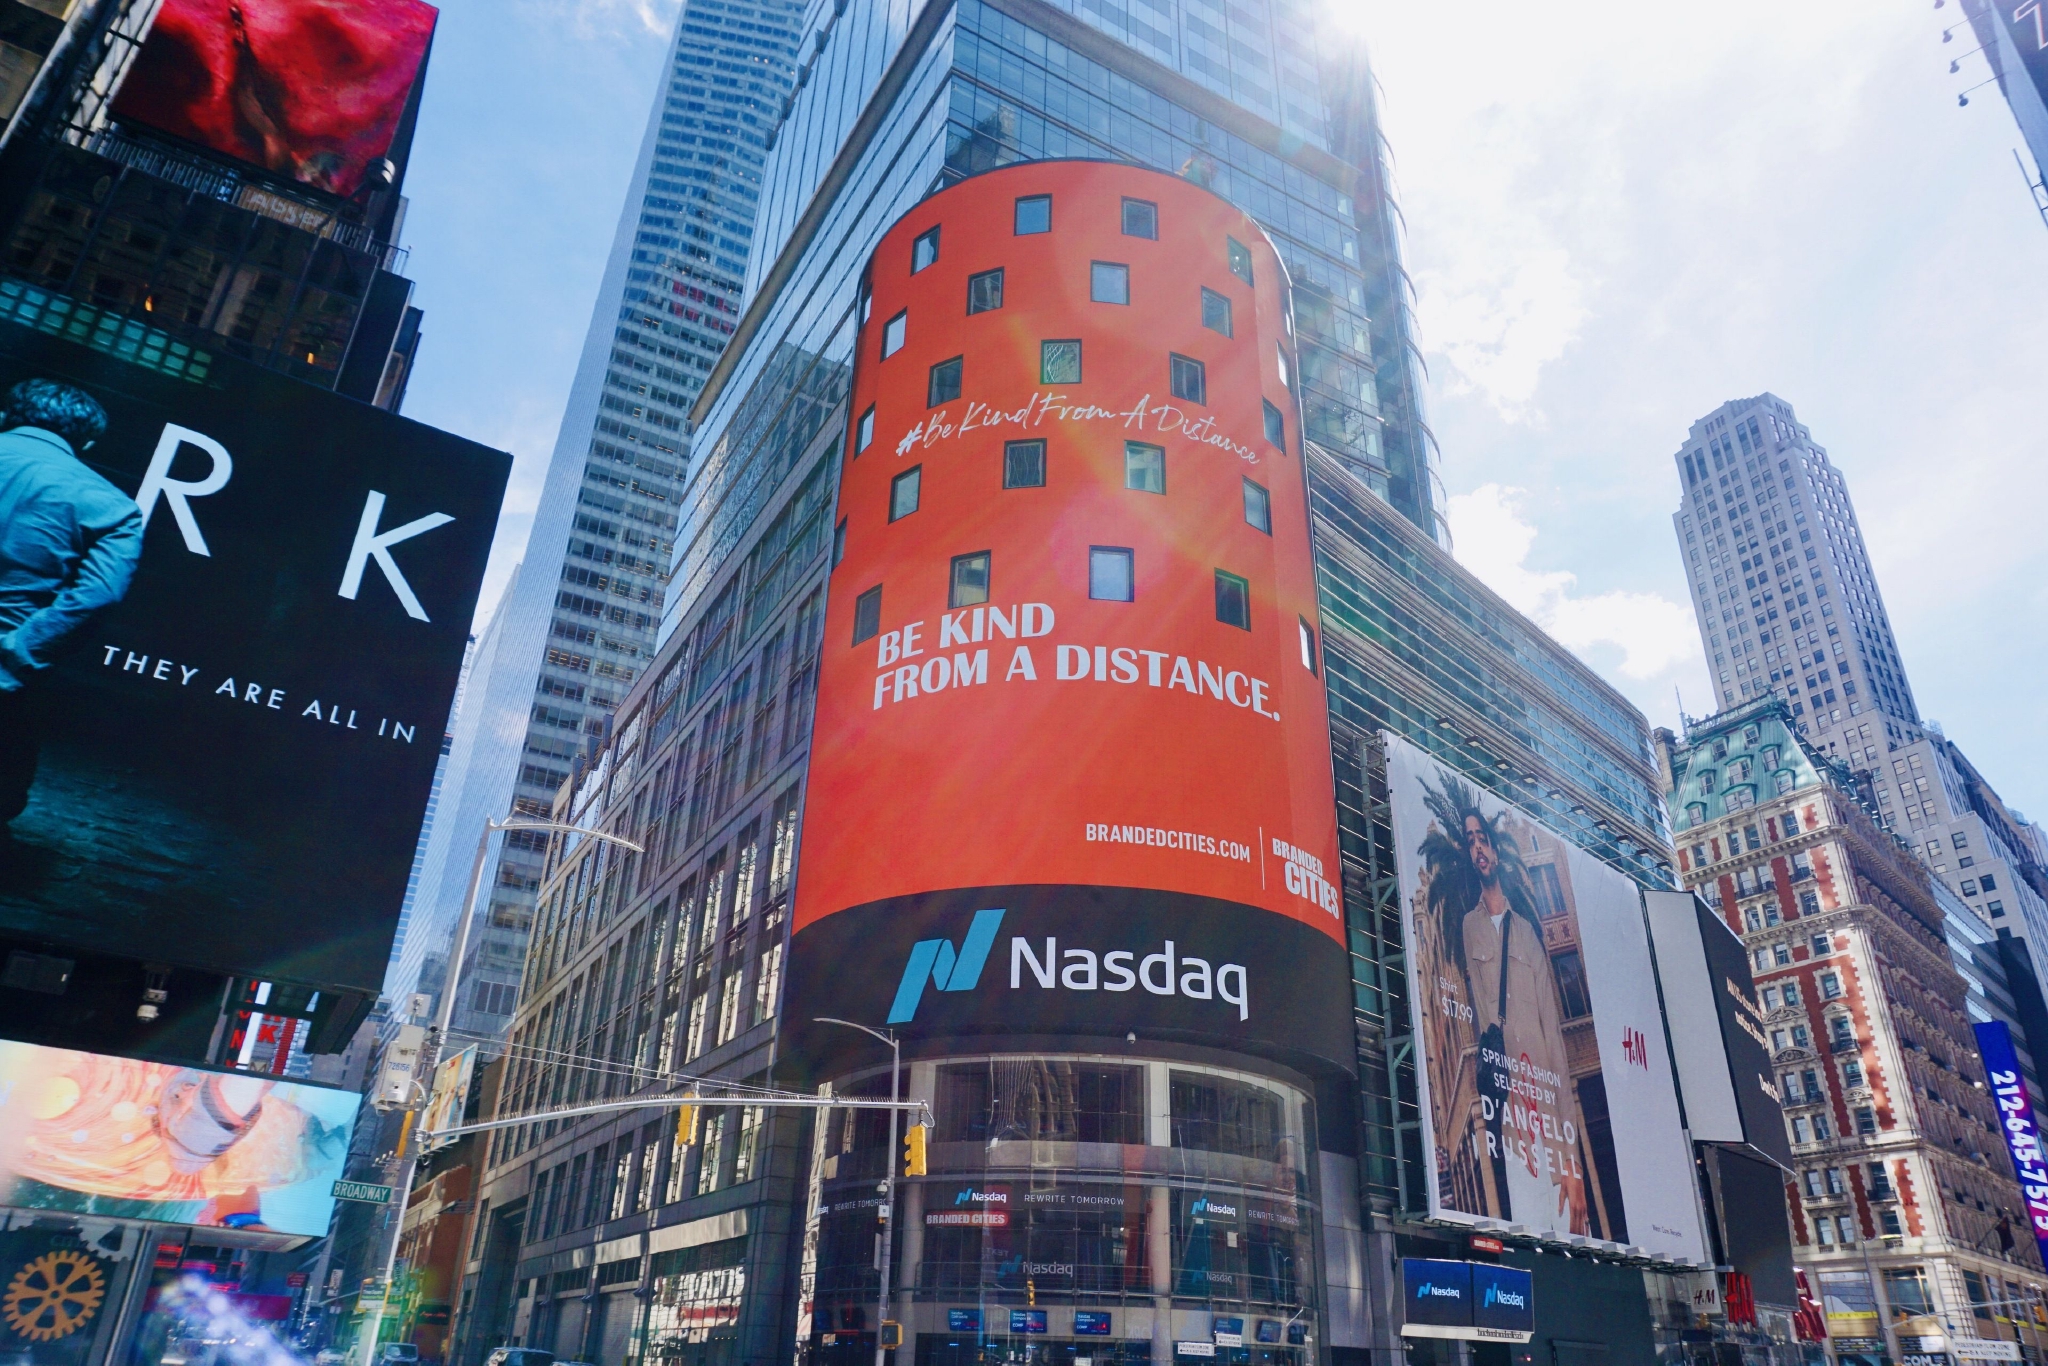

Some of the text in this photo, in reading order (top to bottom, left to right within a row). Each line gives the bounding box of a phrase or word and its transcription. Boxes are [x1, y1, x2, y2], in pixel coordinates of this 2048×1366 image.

[877, 602, 1055, 668] BE KIND
[103, 645, 415, 743] THEY ARE ALL IN
[873, 644, 1280, 722] FROM A DISTANCE.
[1086, 823, 1250, 863] BRANDEDCITIES.COM
[1272, 837, 1323, 877] BRANDED
[1284, 861, 1340, 920] CITIES
[1010, 936, 1249, 1022] Nasdaq
[1441, 995, 1473, 1024] $17.99
[1482, 1048, 1561, 1088] SPRING FASHION
[1622, 1025, 1648, 1071] H&M
[1494, 1072, 1556, 1106] SELECTED BY
[1481, 1094, 1576, 1145] D'ANGELO
[1485, 1130, 1582, 1180] RUSSELL
[333, 1182, 388, 1201] BROADWAY
[972, 1192, 1125, 1205] Nasdaq REWRITE TOMORROW
[926, 1213, 1006, 1224] BRANDED CITIES
[1206, 1203, 1236, 1217] Nasdaq
[1248, 1209, 1275, 1221] REWRITE
[1022, 1261, 1074, 1278] Nasdaq
[1206, 1272, 1233, 1285] Nasdaq
[1431, 1286, 1460, 1298] Nasdaq
[1497, 1290, 1524, 1310] Nasdaq
